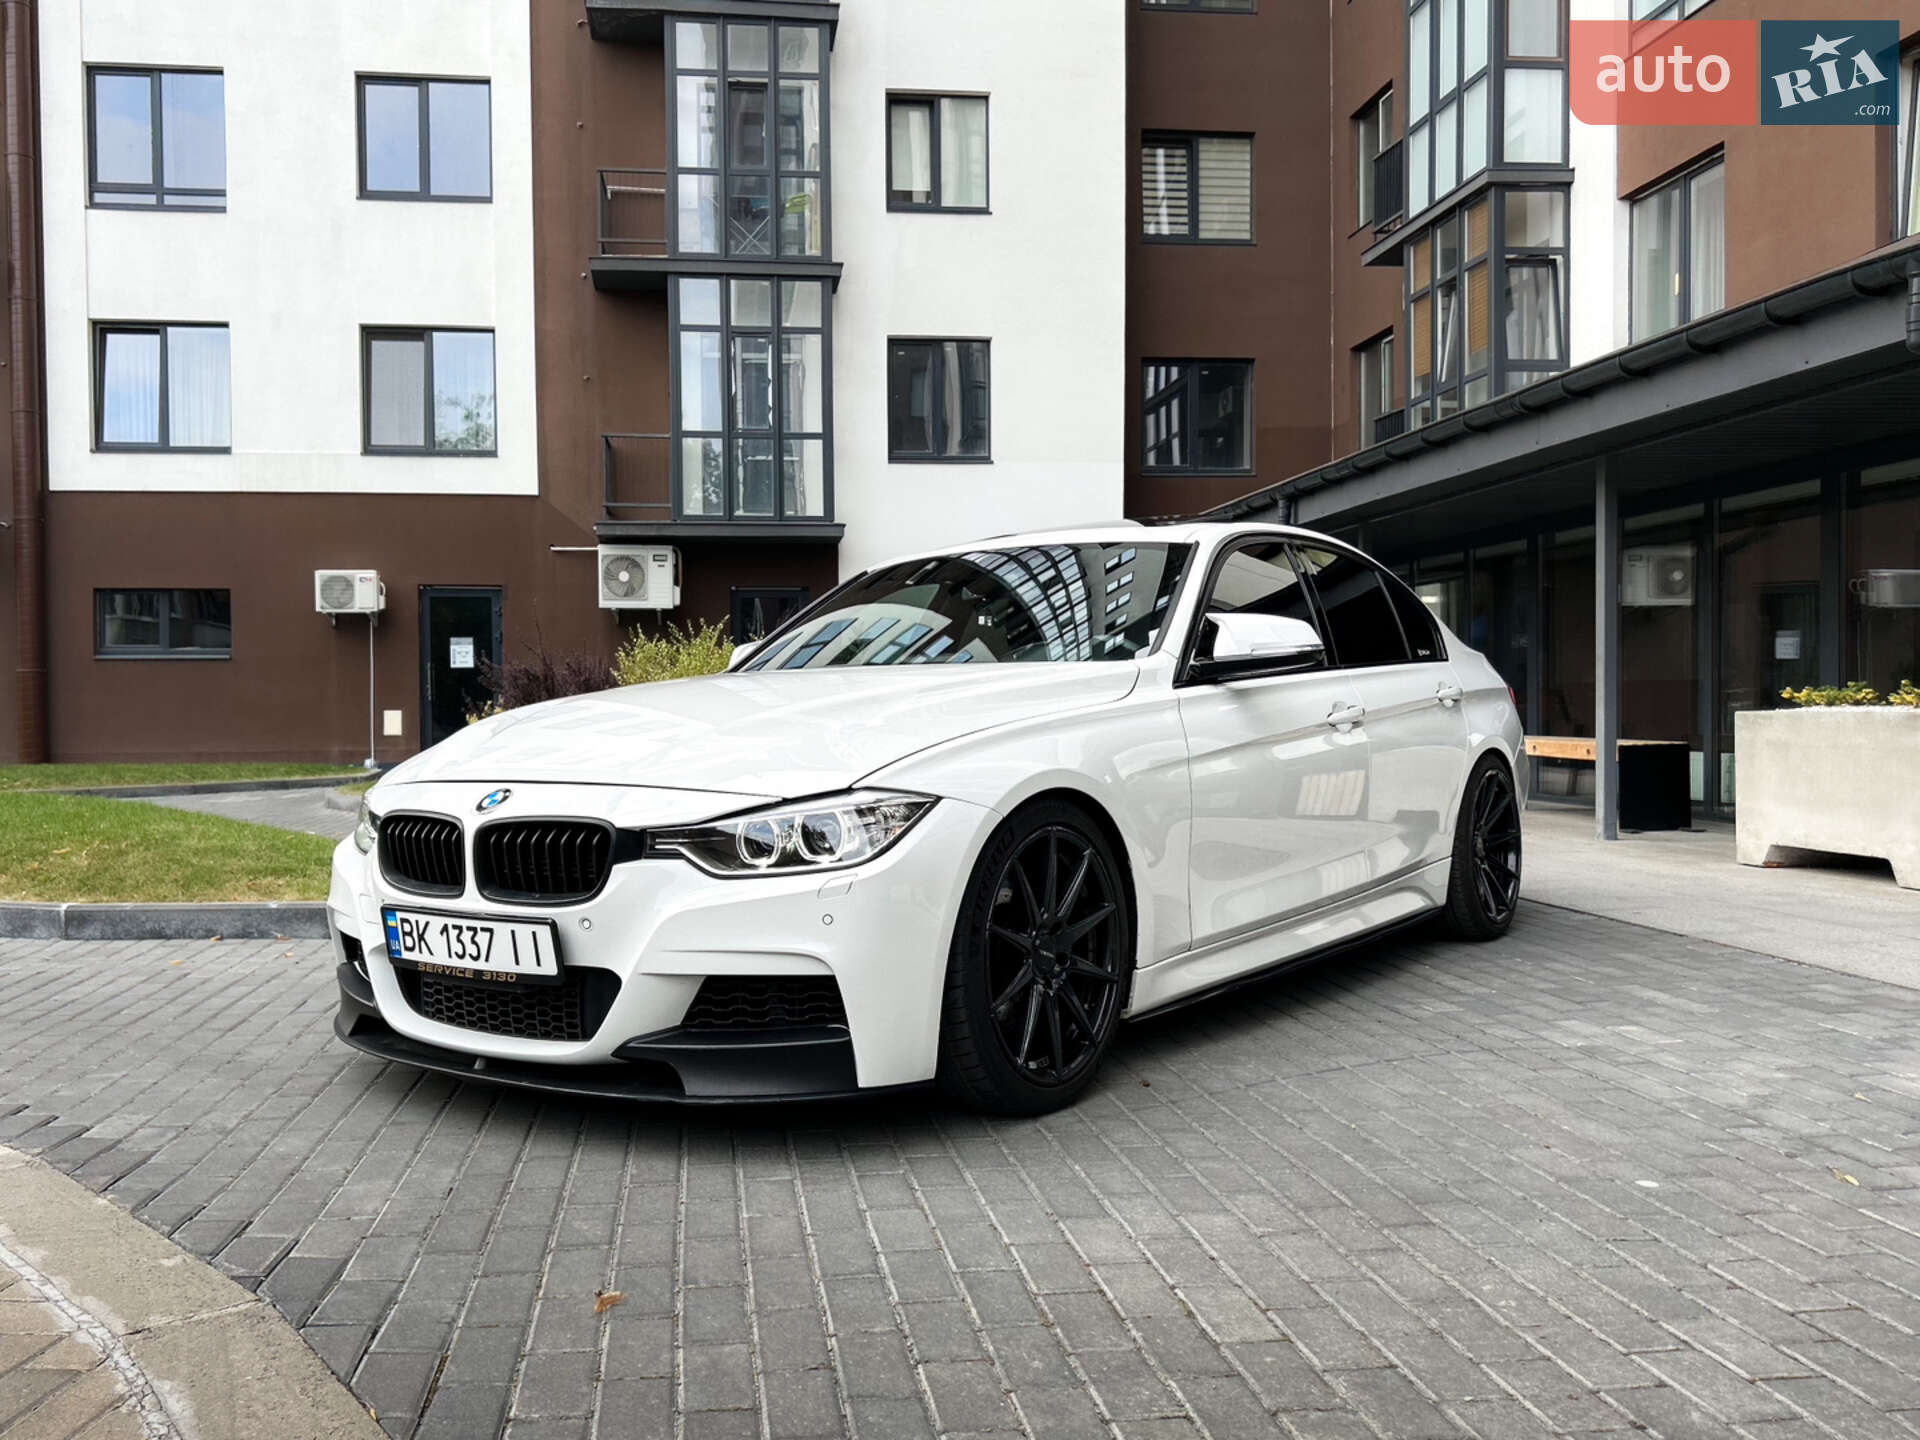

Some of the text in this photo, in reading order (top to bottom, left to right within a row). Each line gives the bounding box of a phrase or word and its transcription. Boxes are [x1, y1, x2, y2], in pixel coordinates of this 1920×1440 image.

[400, 918, 434, 956] BK
[440, 923, 494, 962] 1337
[417, 962, 517, 982] SERVICE 3130
